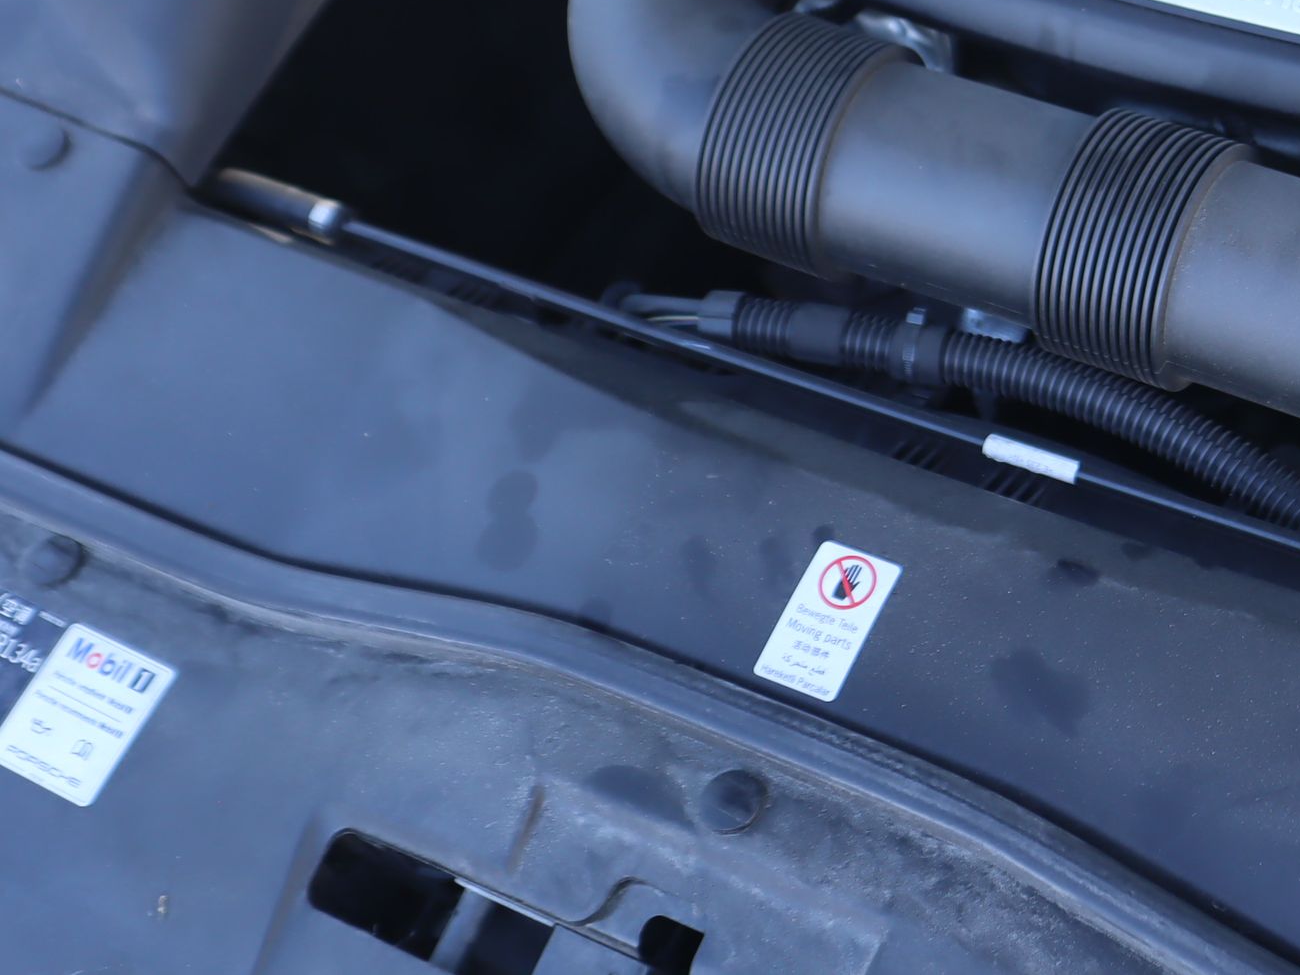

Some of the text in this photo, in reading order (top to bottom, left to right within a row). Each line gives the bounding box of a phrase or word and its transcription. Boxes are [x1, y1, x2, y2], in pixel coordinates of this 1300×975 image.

[786, 617, 852, 650] Moving parts
[67, 638, 133, 683] Mobil
[6, 743, 83, 789] PORSCHE
